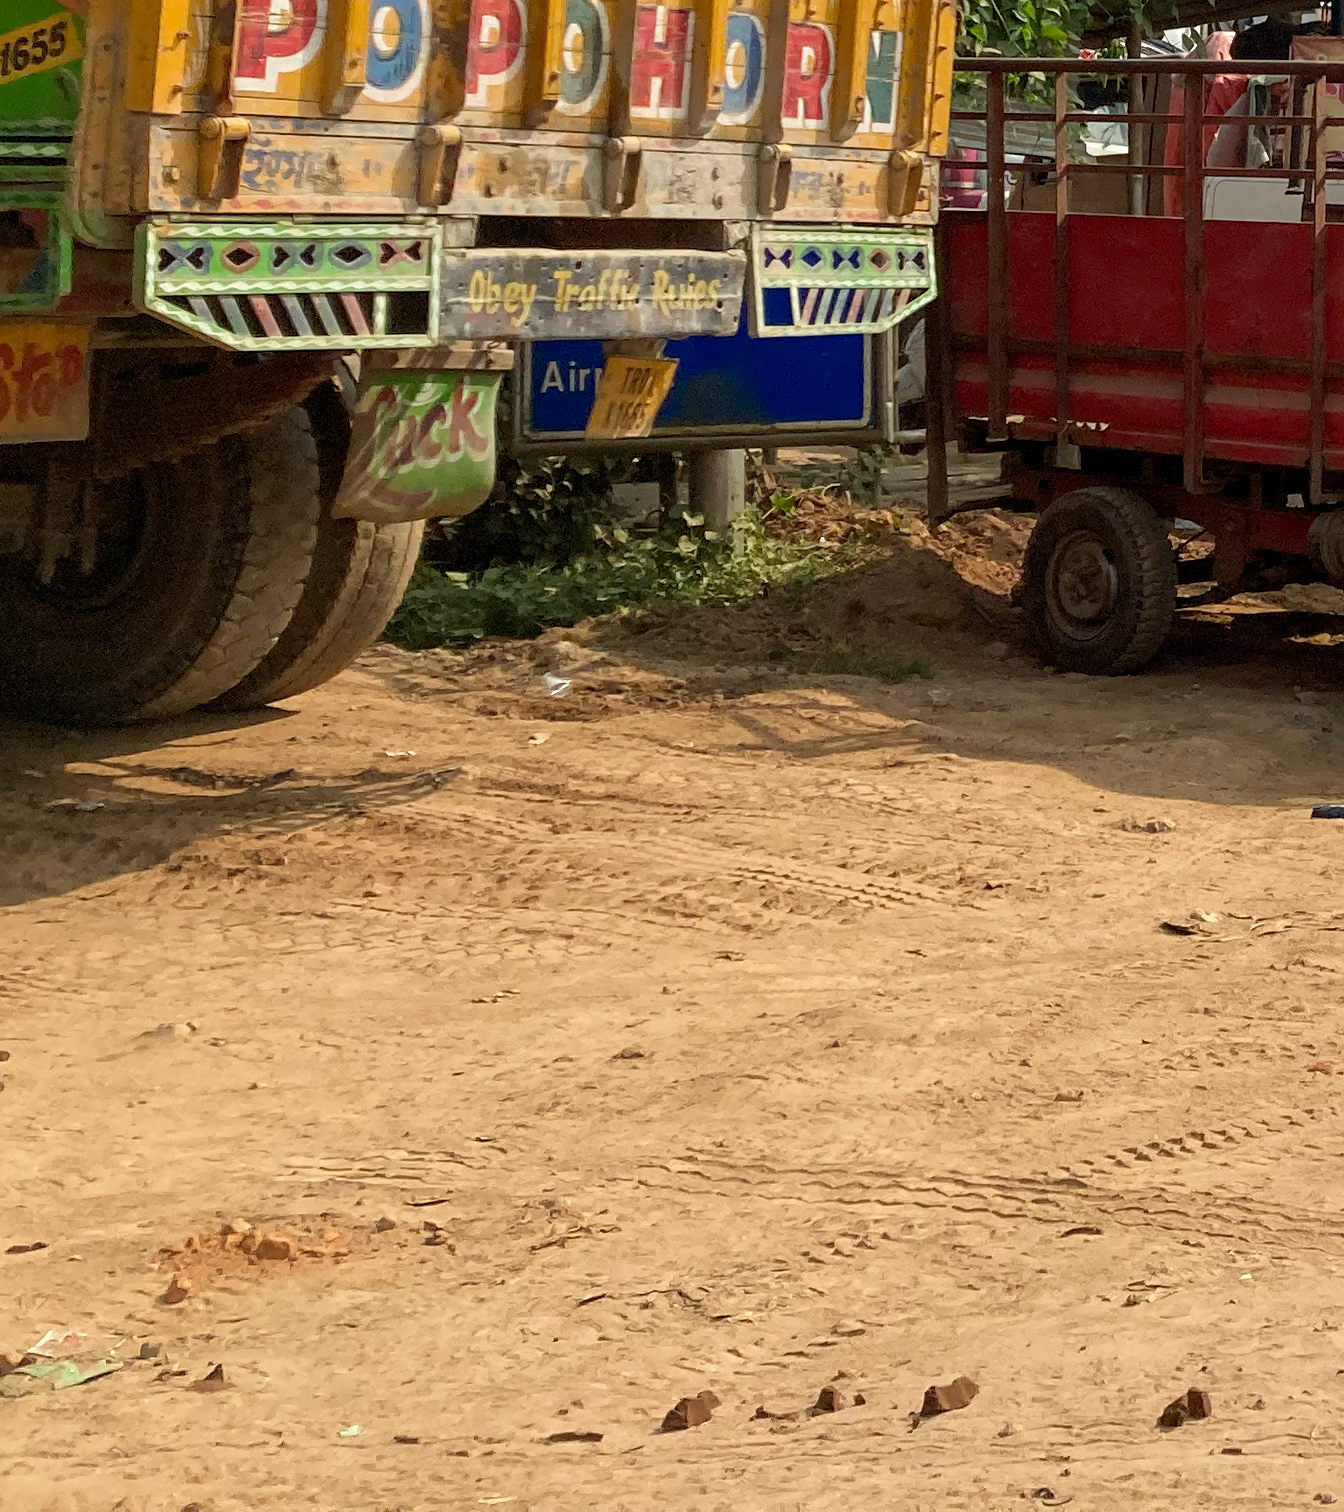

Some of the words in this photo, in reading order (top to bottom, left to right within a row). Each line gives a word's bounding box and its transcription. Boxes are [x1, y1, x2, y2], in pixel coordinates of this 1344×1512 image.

[1, 21, 68, 77] 1655
[469, 269, 537, 328] Obey
[553, 268, 641, 313] Traffic
[652, 269, 722, 320] Rules
